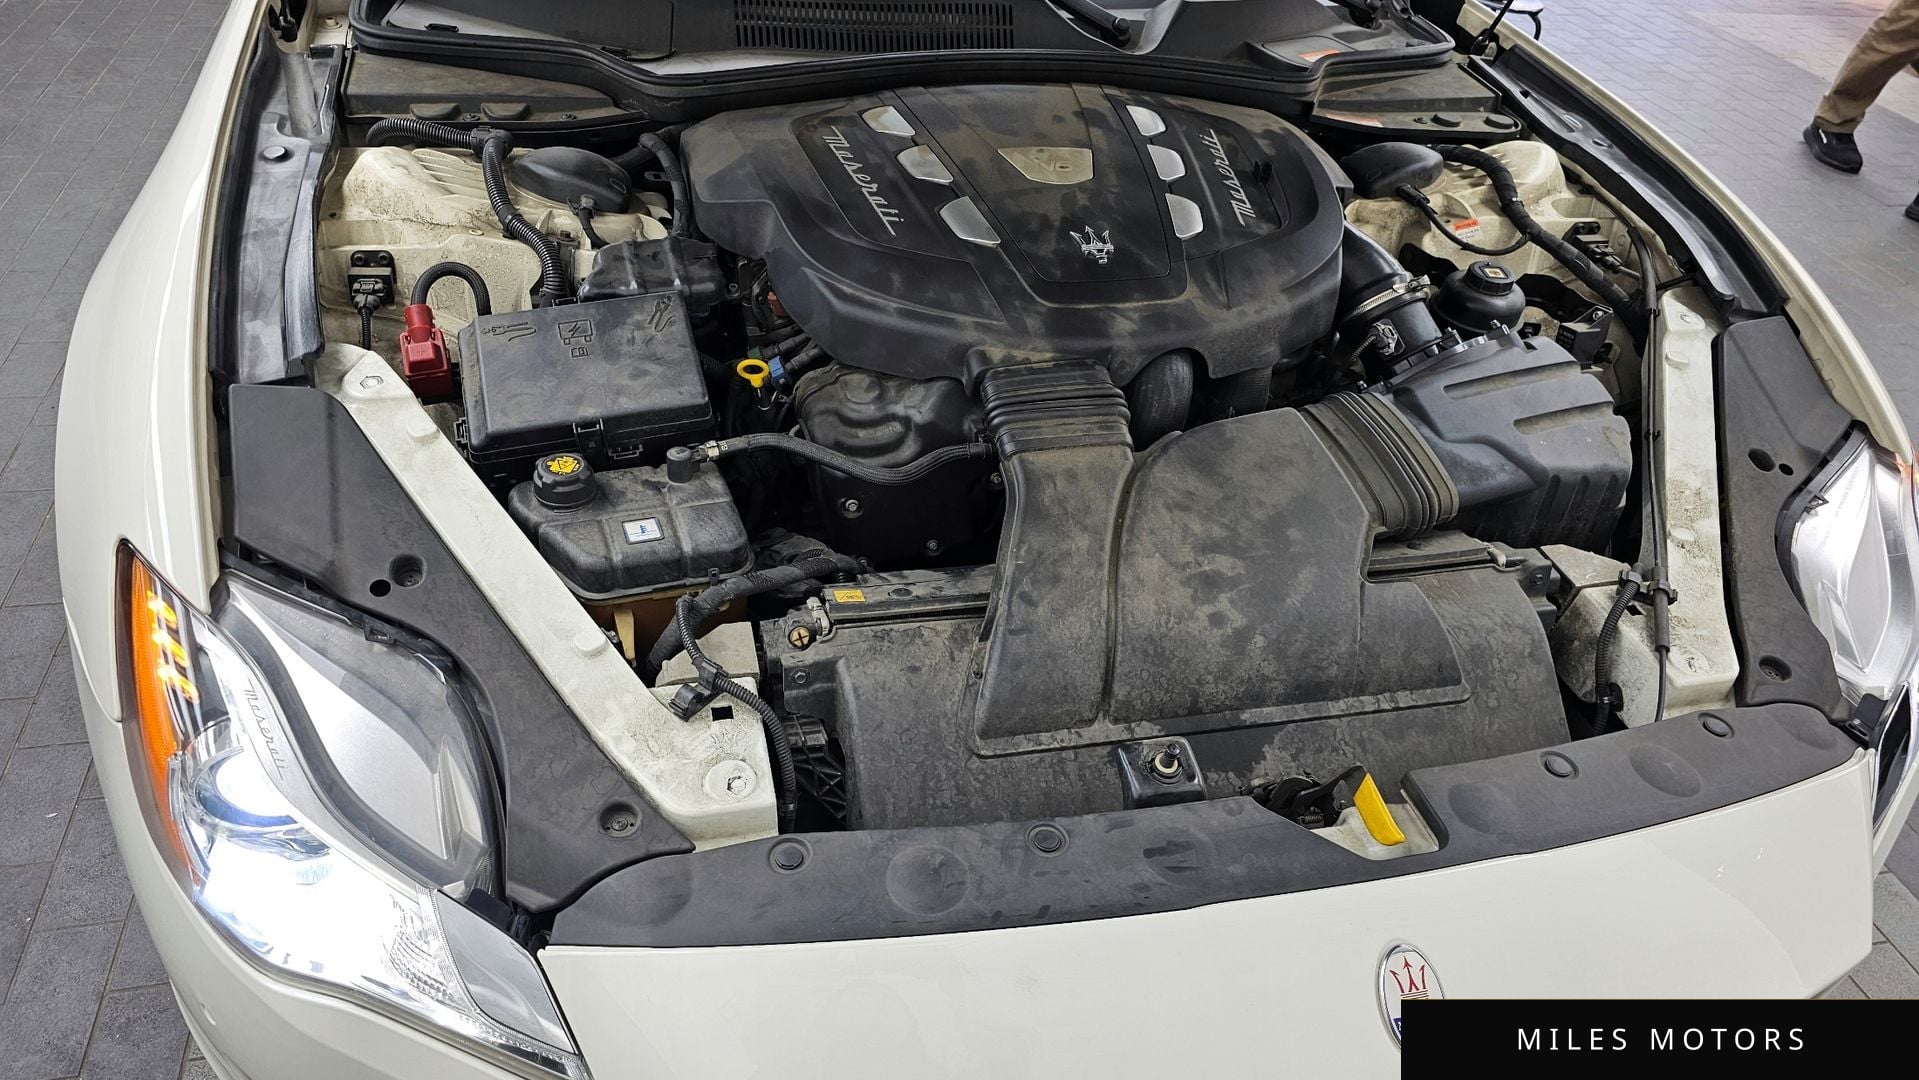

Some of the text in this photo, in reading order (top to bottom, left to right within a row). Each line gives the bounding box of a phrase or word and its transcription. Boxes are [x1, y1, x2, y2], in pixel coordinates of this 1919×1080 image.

[822, 125, 904, 236] Maserati
[1200, 128, 1256, 227] Maserati
[244, 679, 289, 781] Maserati
